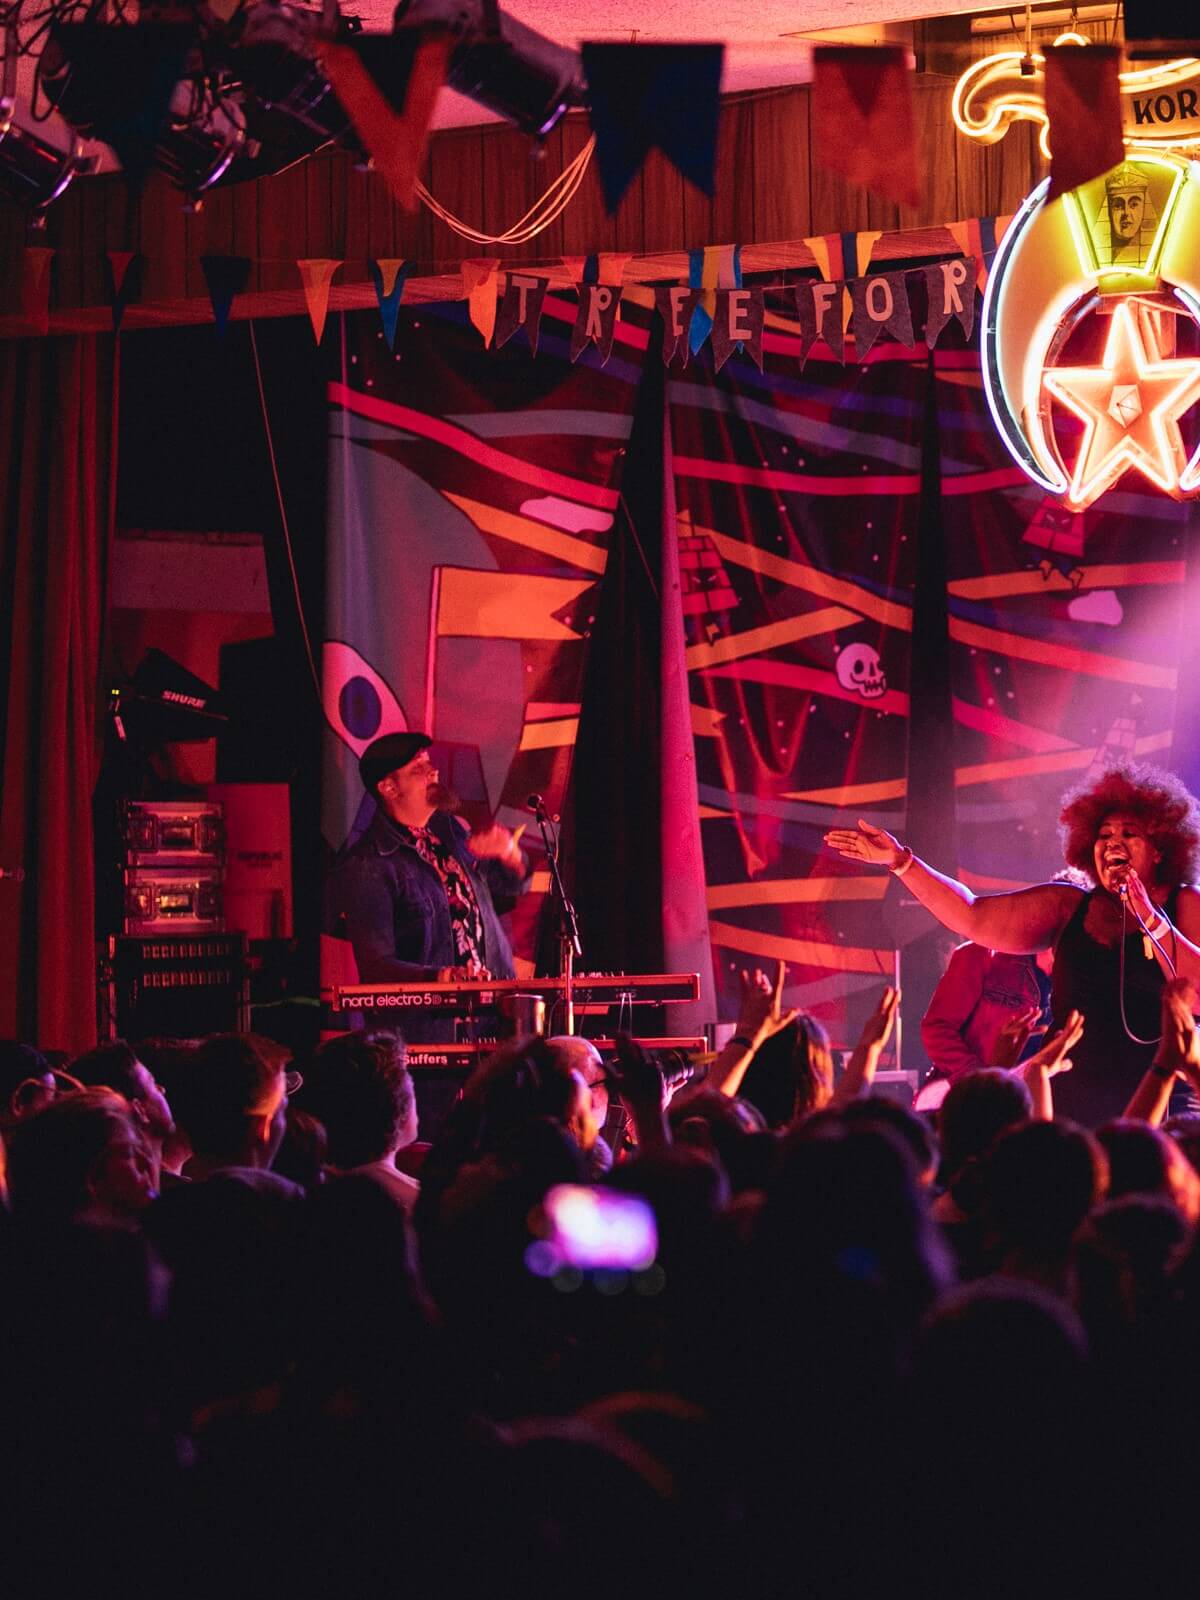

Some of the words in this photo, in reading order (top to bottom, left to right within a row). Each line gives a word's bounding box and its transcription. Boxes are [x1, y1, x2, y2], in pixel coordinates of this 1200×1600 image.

[511, 259, 967, 340] TREEFOR
[162, 689, 206, 709] SHURE
[342, 994, 374, 1008] nord
[376, 993, 423, 1006] electro
[403, 1053, 448, 1066] Suffers
